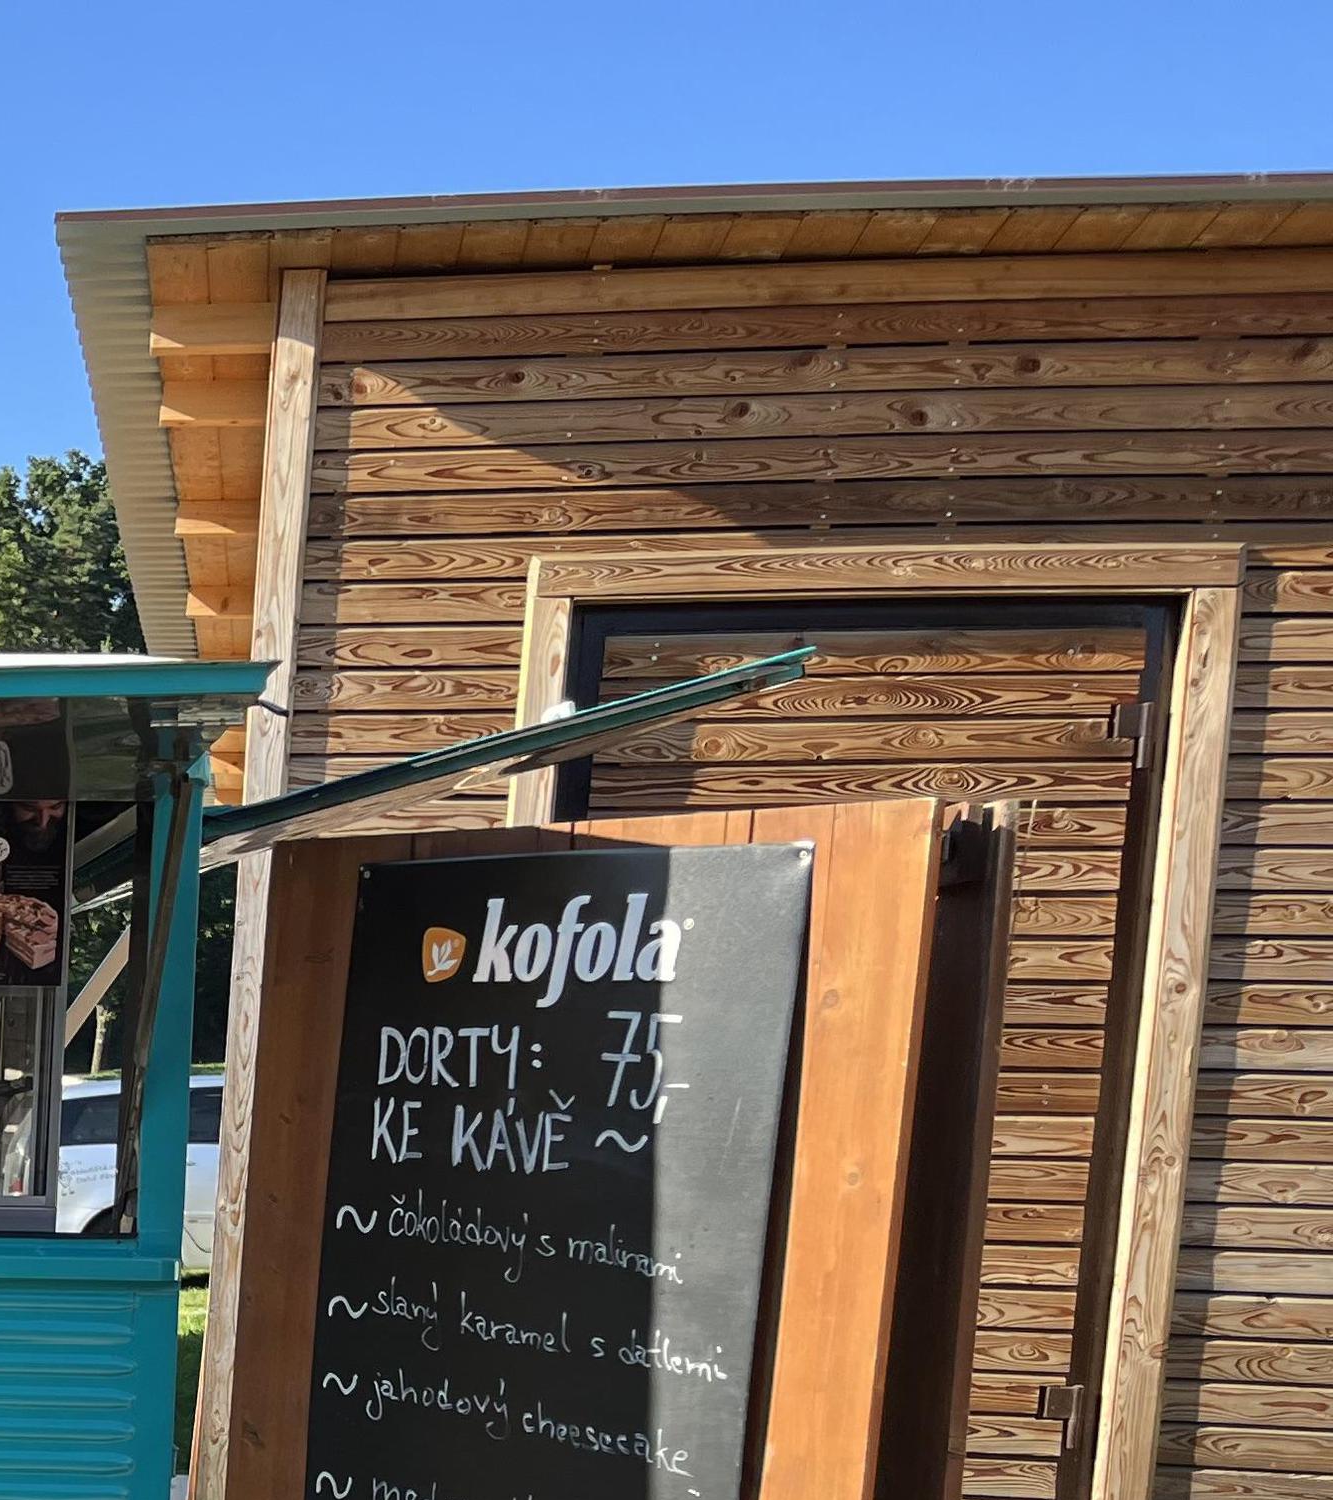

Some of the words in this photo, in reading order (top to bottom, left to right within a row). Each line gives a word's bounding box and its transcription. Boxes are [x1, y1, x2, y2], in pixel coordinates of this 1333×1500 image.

[471, 893, 684, 1008] kofola
[370, 1096, 423, 1165] KE
[451, 1088, 576, 1175] KÁVĚ
[460, 1290, 572, 1354] karamel
[589, 1338, 606, 1359] s
[618, 1328, 728, 1383] datlemi
[365, 1368, 511, 1441] jahodový
